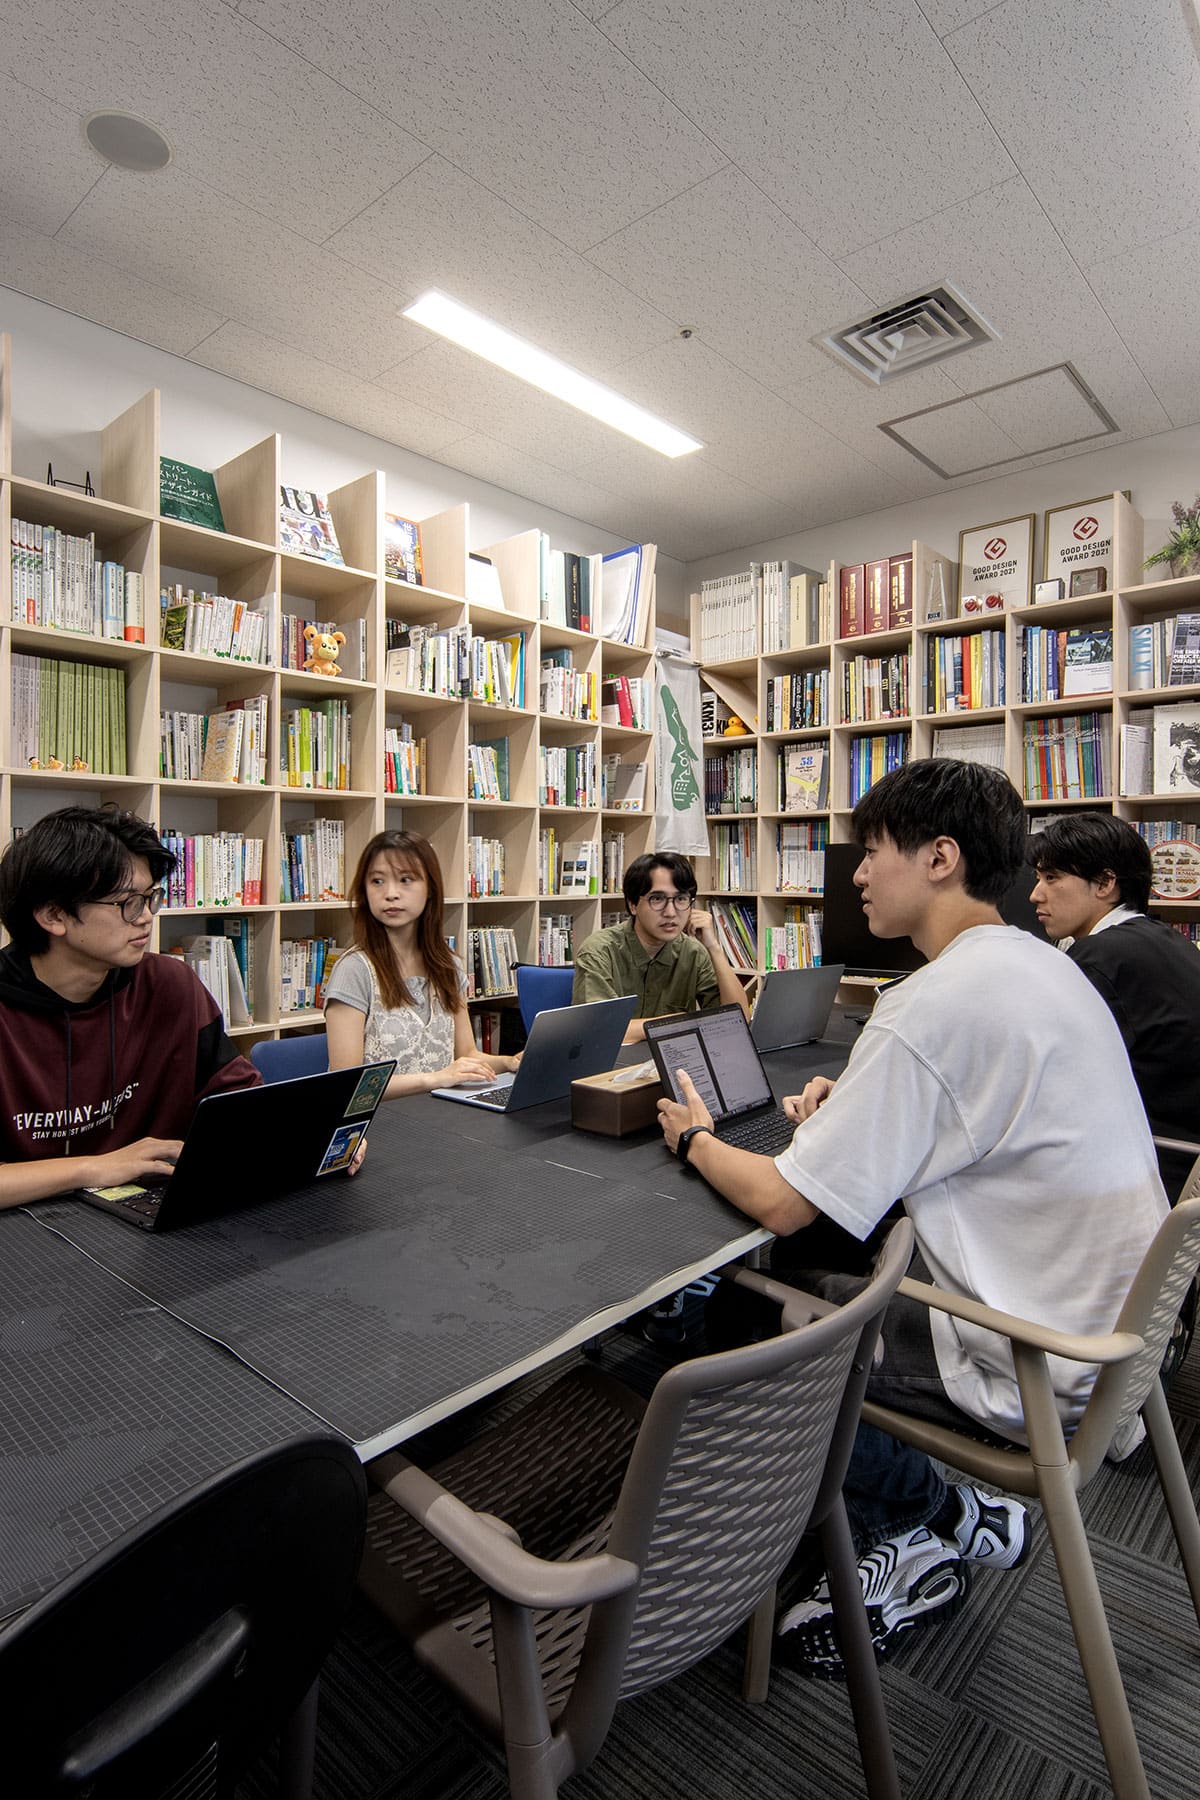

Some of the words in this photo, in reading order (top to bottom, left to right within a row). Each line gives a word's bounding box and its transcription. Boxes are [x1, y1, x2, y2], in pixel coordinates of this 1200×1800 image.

[160, 460, 188, 474] ーバン
[1060, 546, 1081, 557] GOOD
[1082, 539, 1111, 552] DESIGN
[1062, 552, 1089, 563] AWARD
[1090, 548, 1109, 558] 2021
[972, 564, 991, 575] GOOD
[992, 559, 1018, 571] DESIGN
[974, 571, 998, 582] AWARD
[999, 567, 1016, 577] 2021
[702, 700, 714, 731] KM3
[32, 1131, 50, 1140] STAY
[52, 1127, 79, 1139] HONST
